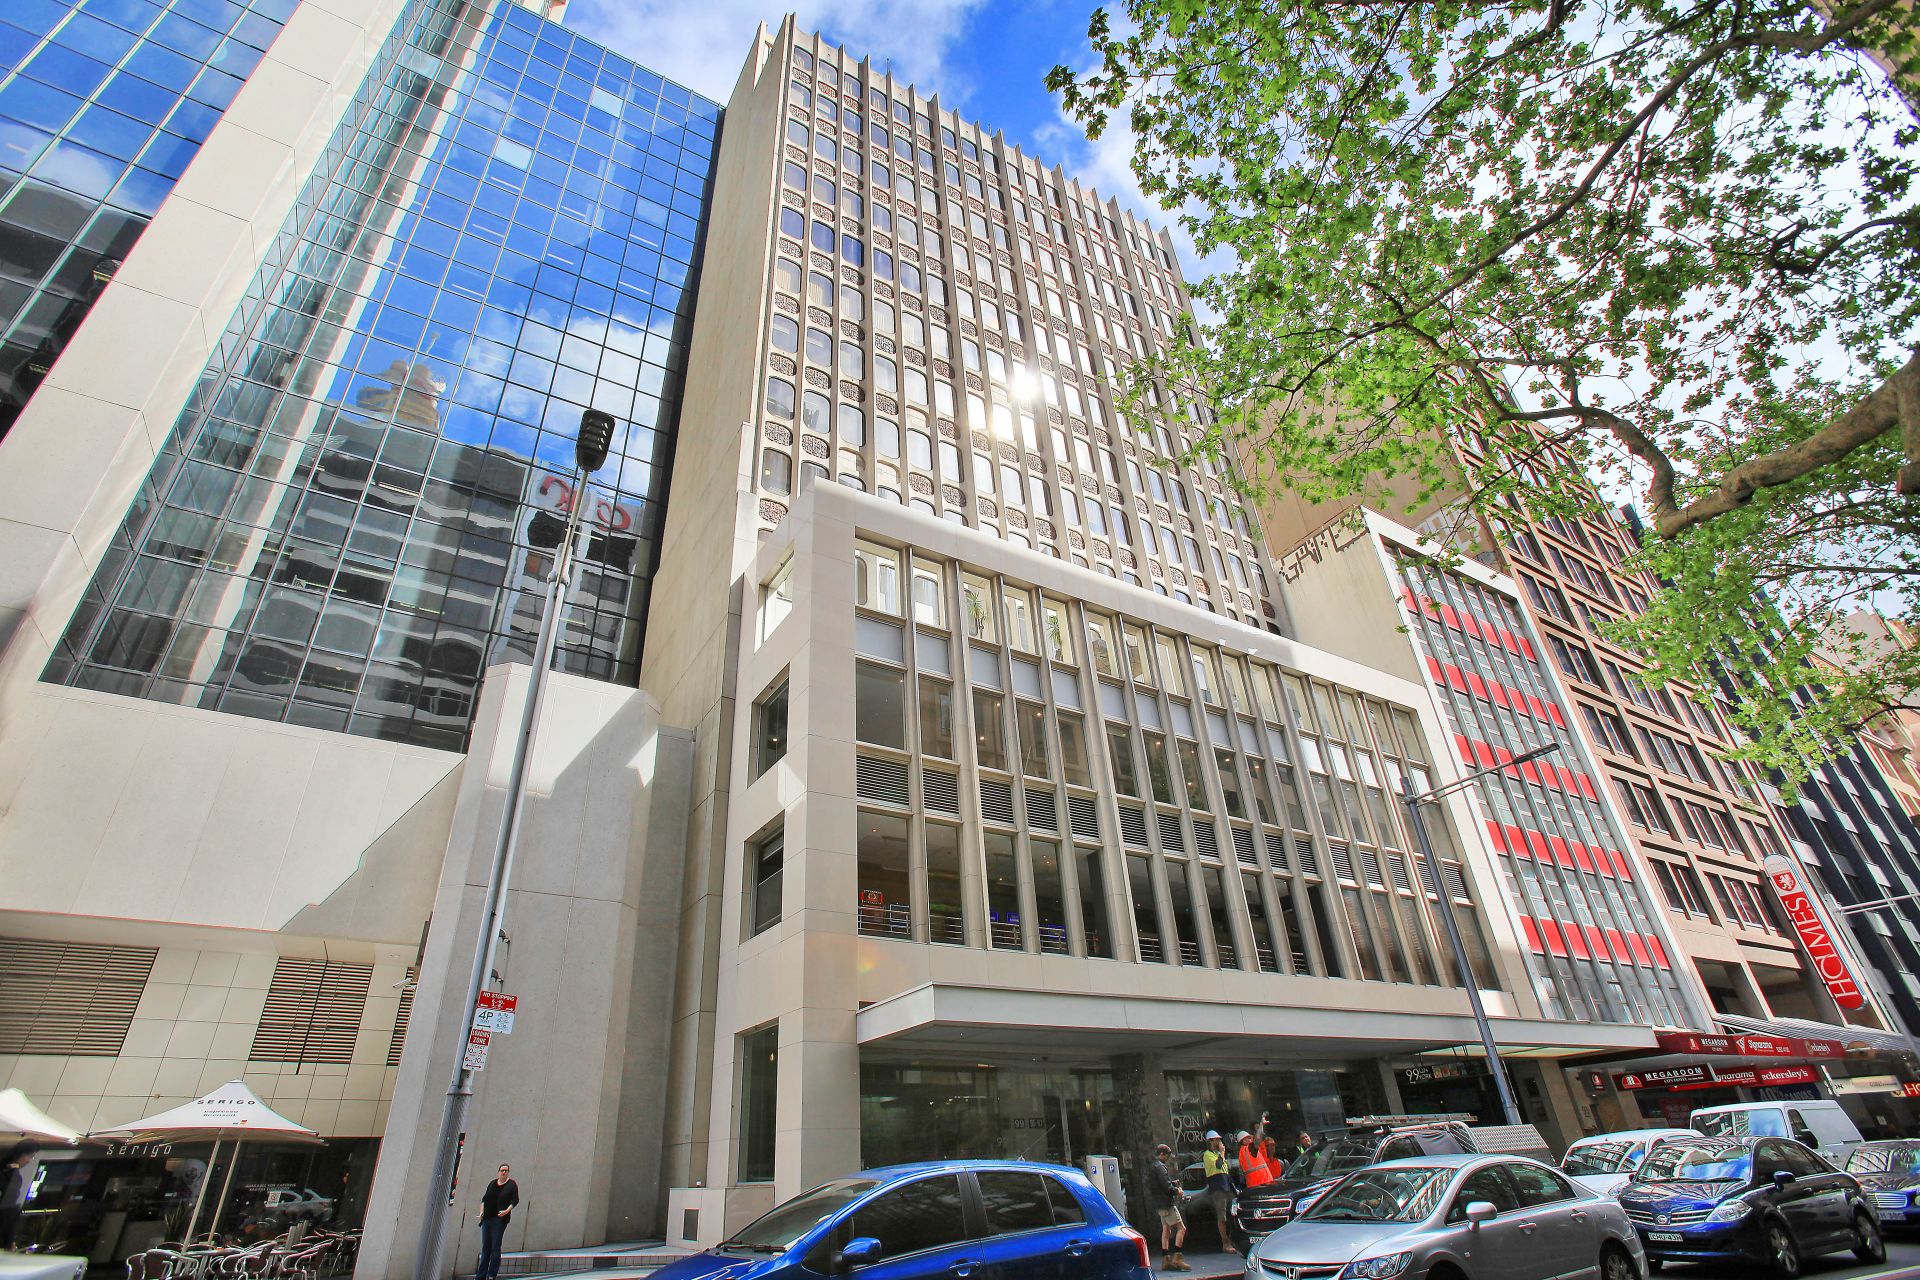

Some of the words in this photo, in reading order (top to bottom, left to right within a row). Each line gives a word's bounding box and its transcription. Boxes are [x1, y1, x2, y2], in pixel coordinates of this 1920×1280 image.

[1786, 897, 1859, 998] HOLMES
[479, 1010, 494, 1020] 4P
[473, 1037, 487, 1045] ZONE
[1406, 1069, 1419, 1080] 99
[1645, 1067, 1703, 1080] MEGABOOM
[1717, 1071, 1755, 1082] gnarama
[1181, 1130, 1206, 1142] YORK
[107, 1143, 172, 1157] serigo
